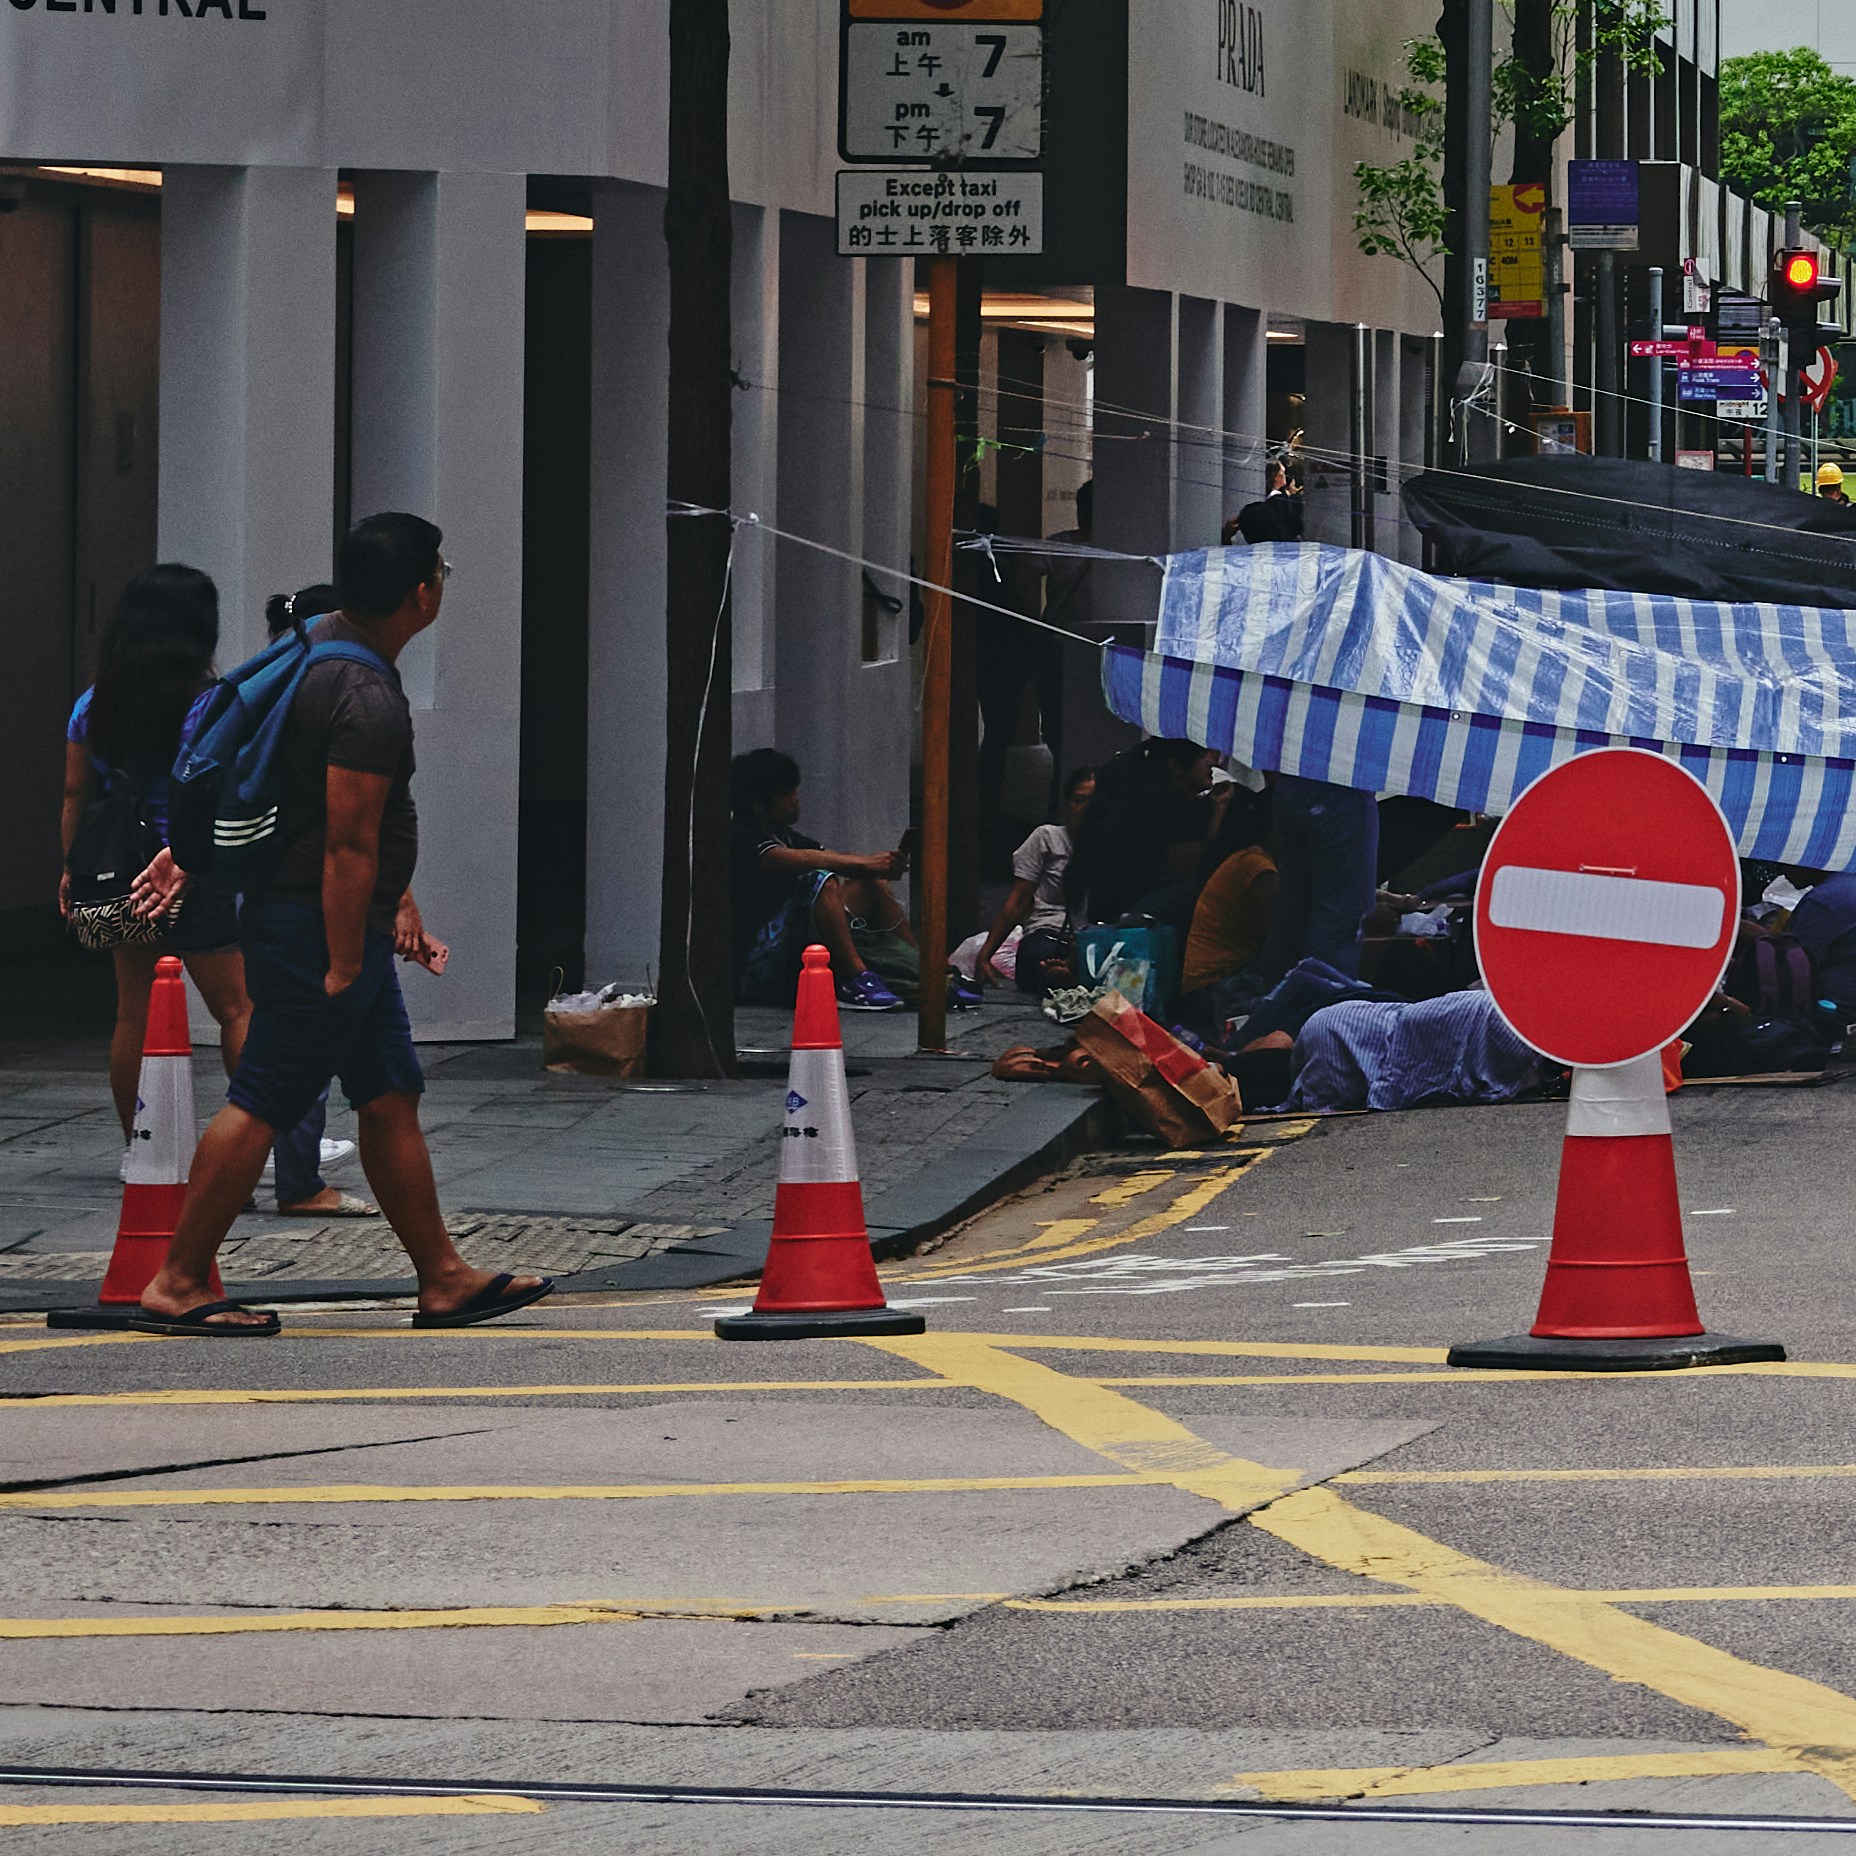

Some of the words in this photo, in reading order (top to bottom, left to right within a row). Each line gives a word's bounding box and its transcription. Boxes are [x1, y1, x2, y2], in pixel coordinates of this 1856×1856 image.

[897, 29, 931, 47] am
[885, 52, 943, 78] 上午
[974, 35, 1007, 78] 7
[895, 100, 931, 121] pm
[884, 125, 942, 151] 下午
[973, 106, 1007, 150] 7
[885, 178, 956, 199] Except
[960, 178, 997, 197] taxi
[859, 198, 903, 220] pick
[907, 198, 987, 220] up/drop
[992, 198, 1021, 217] off
[848, 223, 1031, 248] 的士上落客除外
[1475, 262, 1486, 319] 16377
